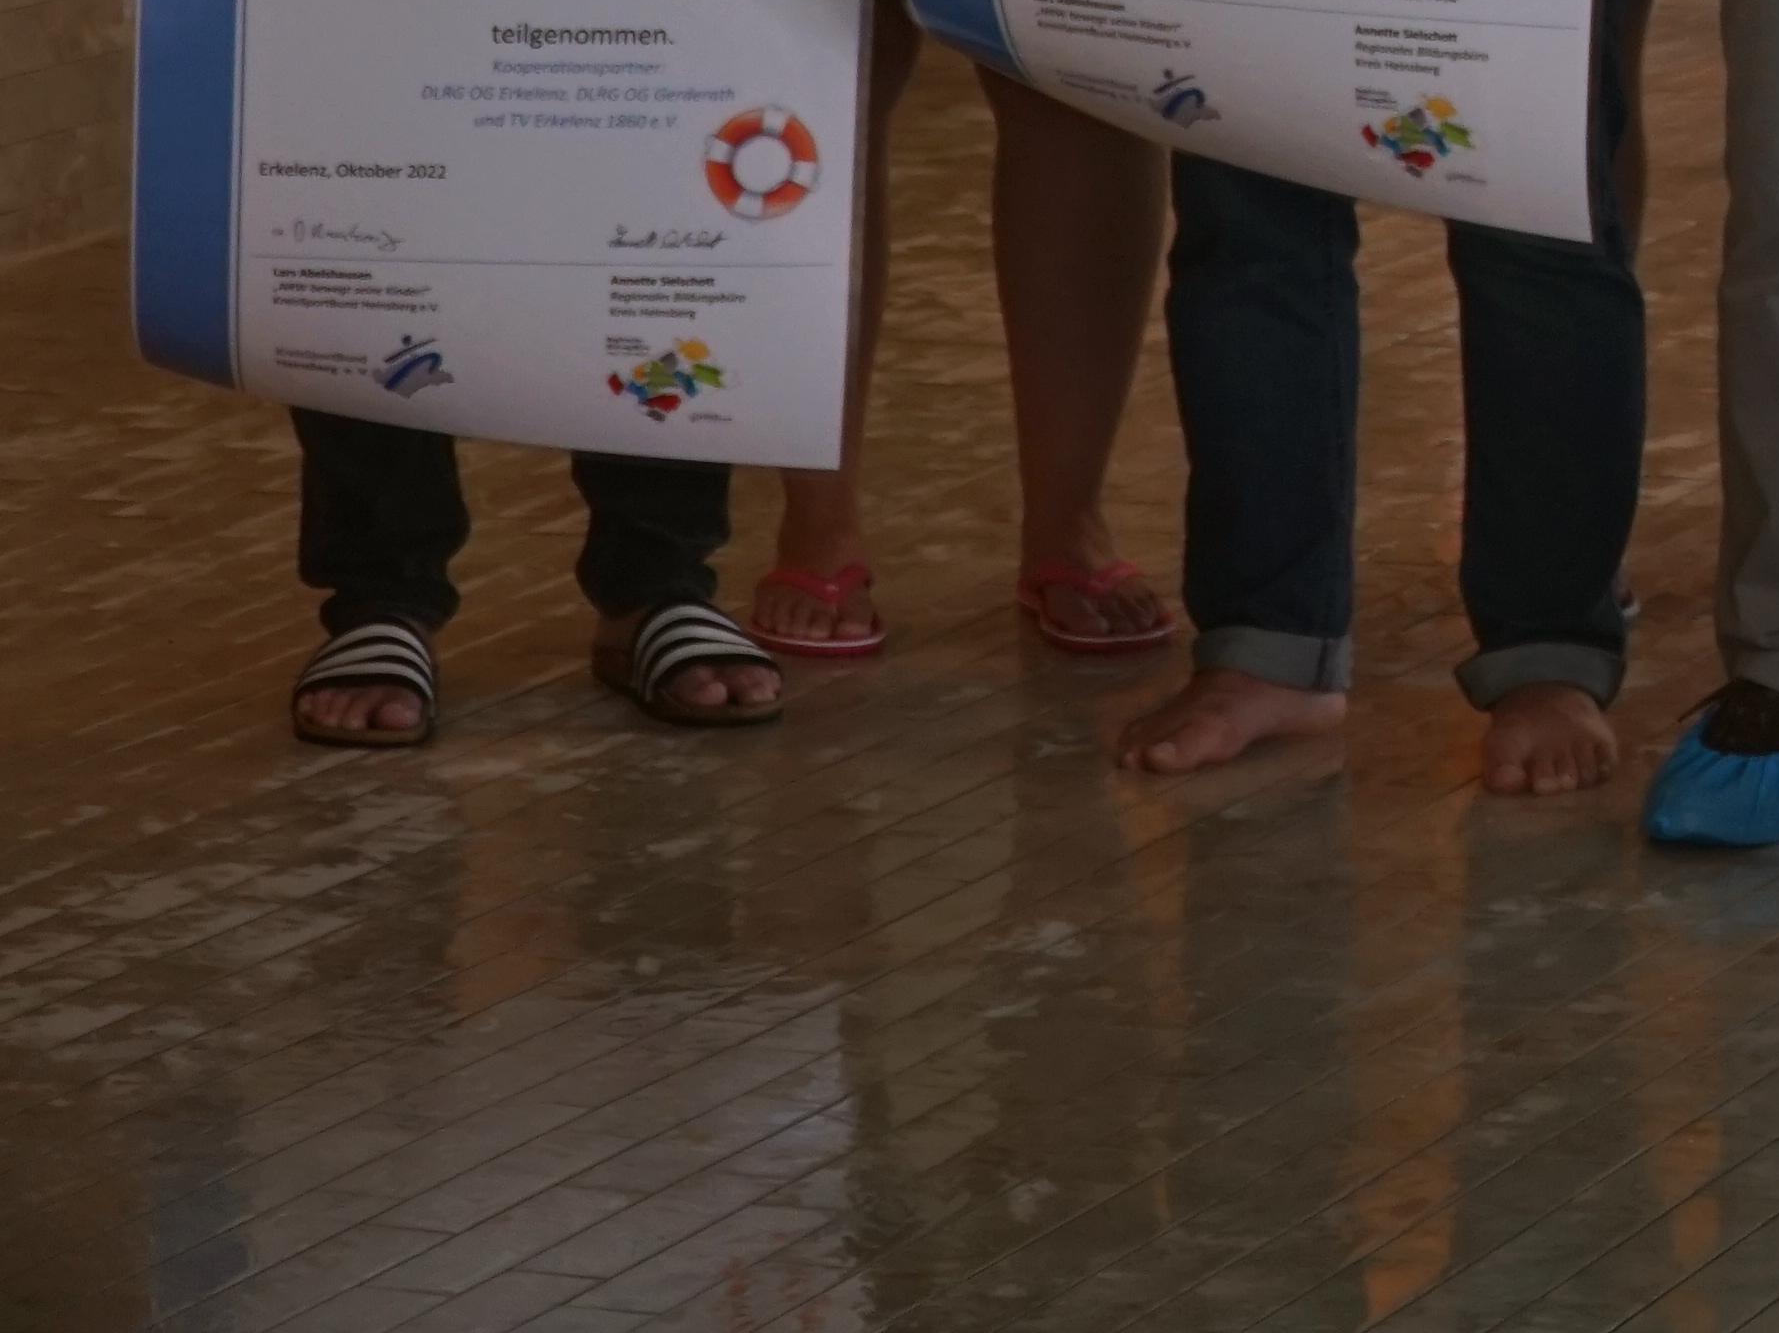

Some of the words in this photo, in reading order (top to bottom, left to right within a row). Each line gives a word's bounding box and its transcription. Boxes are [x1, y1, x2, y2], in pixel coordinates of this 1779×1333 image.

[491, 23, 674, 50] teilgenommen.
[259, 161, 331, 183] Erkelenz,
[337, 162, 402, 182] Oktober
[407, 162, 447, 181] 2022
